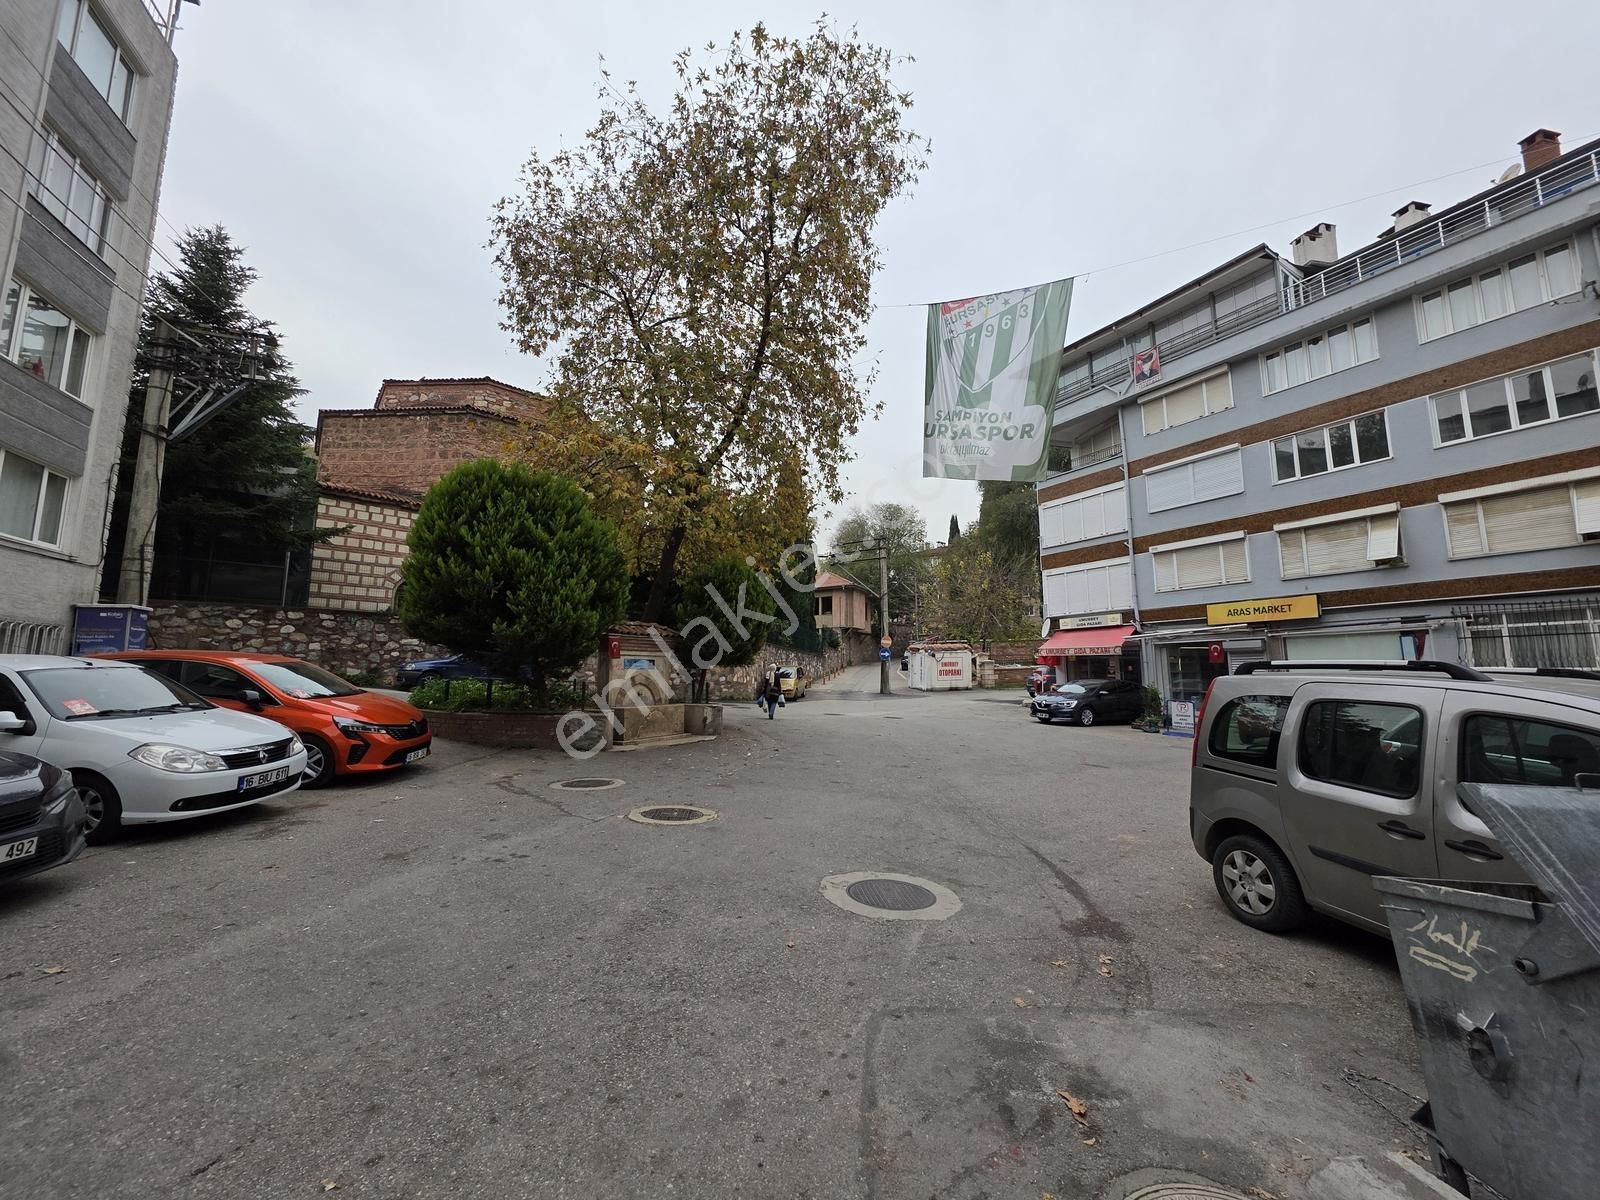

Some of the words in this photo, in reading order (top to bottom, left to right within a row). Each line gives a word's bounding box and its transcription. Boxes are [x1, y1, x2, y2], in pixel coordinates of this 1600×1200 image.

[968, 304, 1030, 348] 1963
[923, 422, 1035, 441] URSASPOR
[1226, 607, 1252, 617] ARAS
[1253, 604, 1293, 616] MARKET
[245, 776, 255, 787] 16
[275, 768, 288, 780] 611
[5, 839, 35, 859] 492
